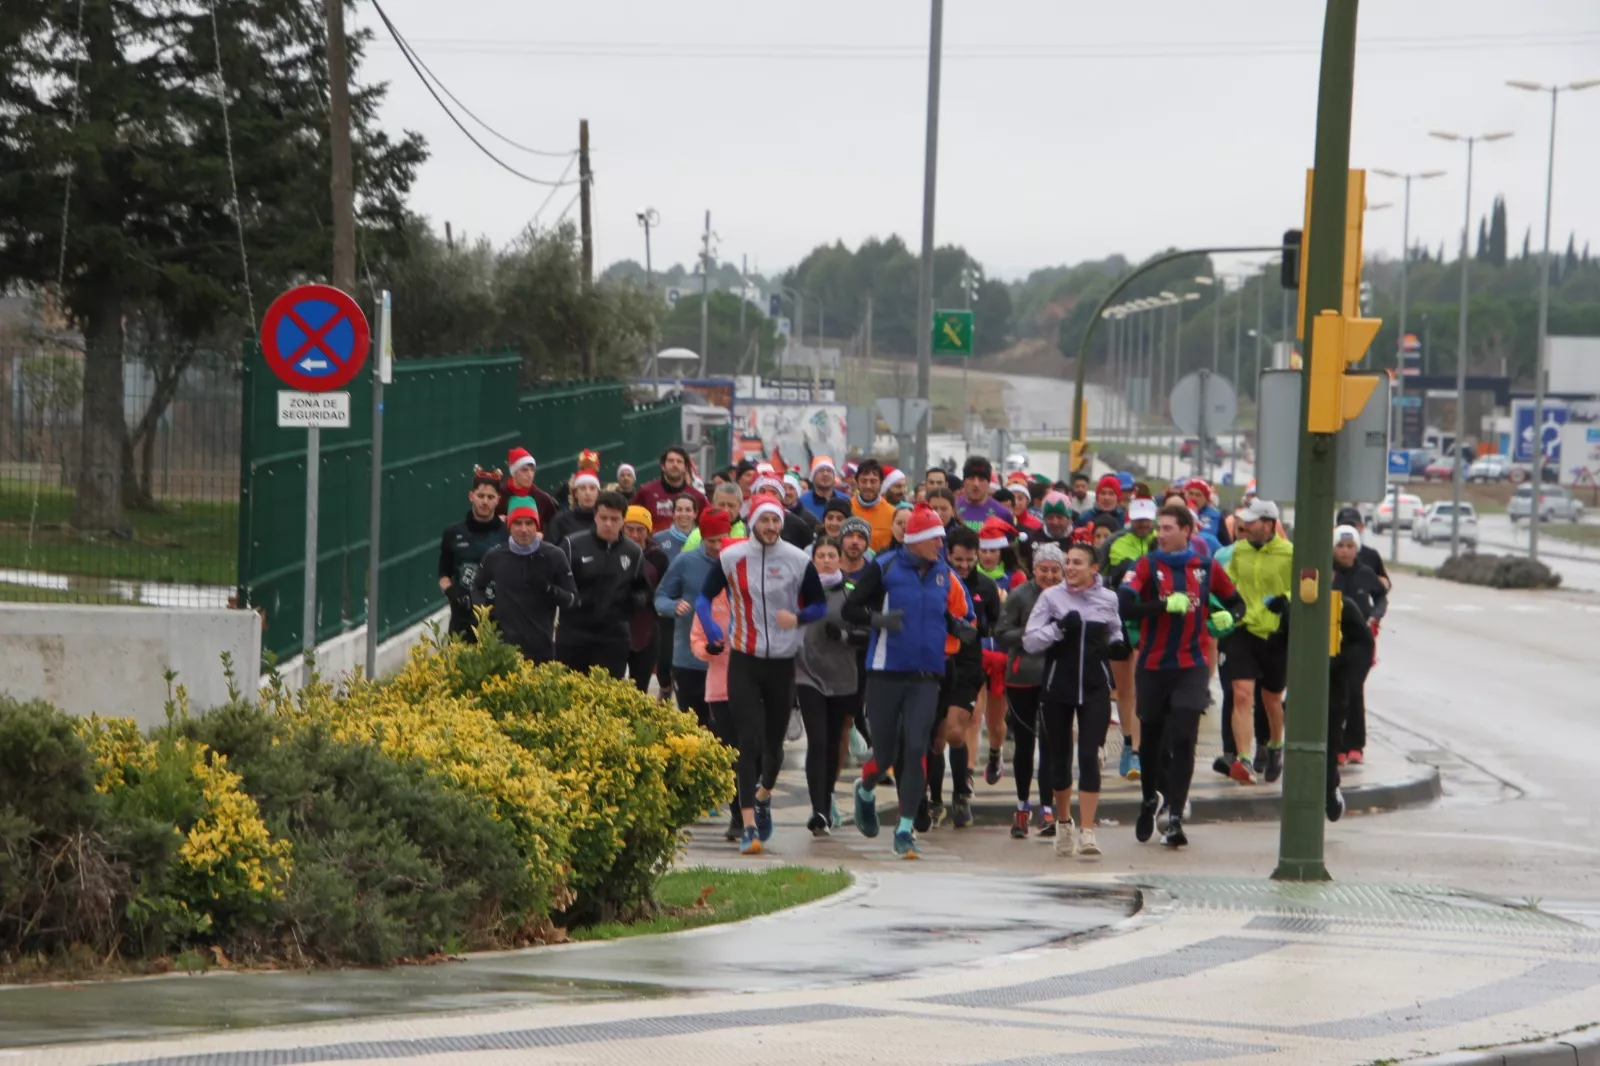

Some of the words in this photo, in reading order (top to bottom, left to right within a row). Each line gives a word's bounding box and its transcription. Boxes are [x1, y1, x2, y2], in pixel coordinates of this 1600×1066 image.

[289, 398, 320, 409] ZONA
[323, 398, 337, 409] DE
[282, 410, 346, 420] SEGURIDAD
